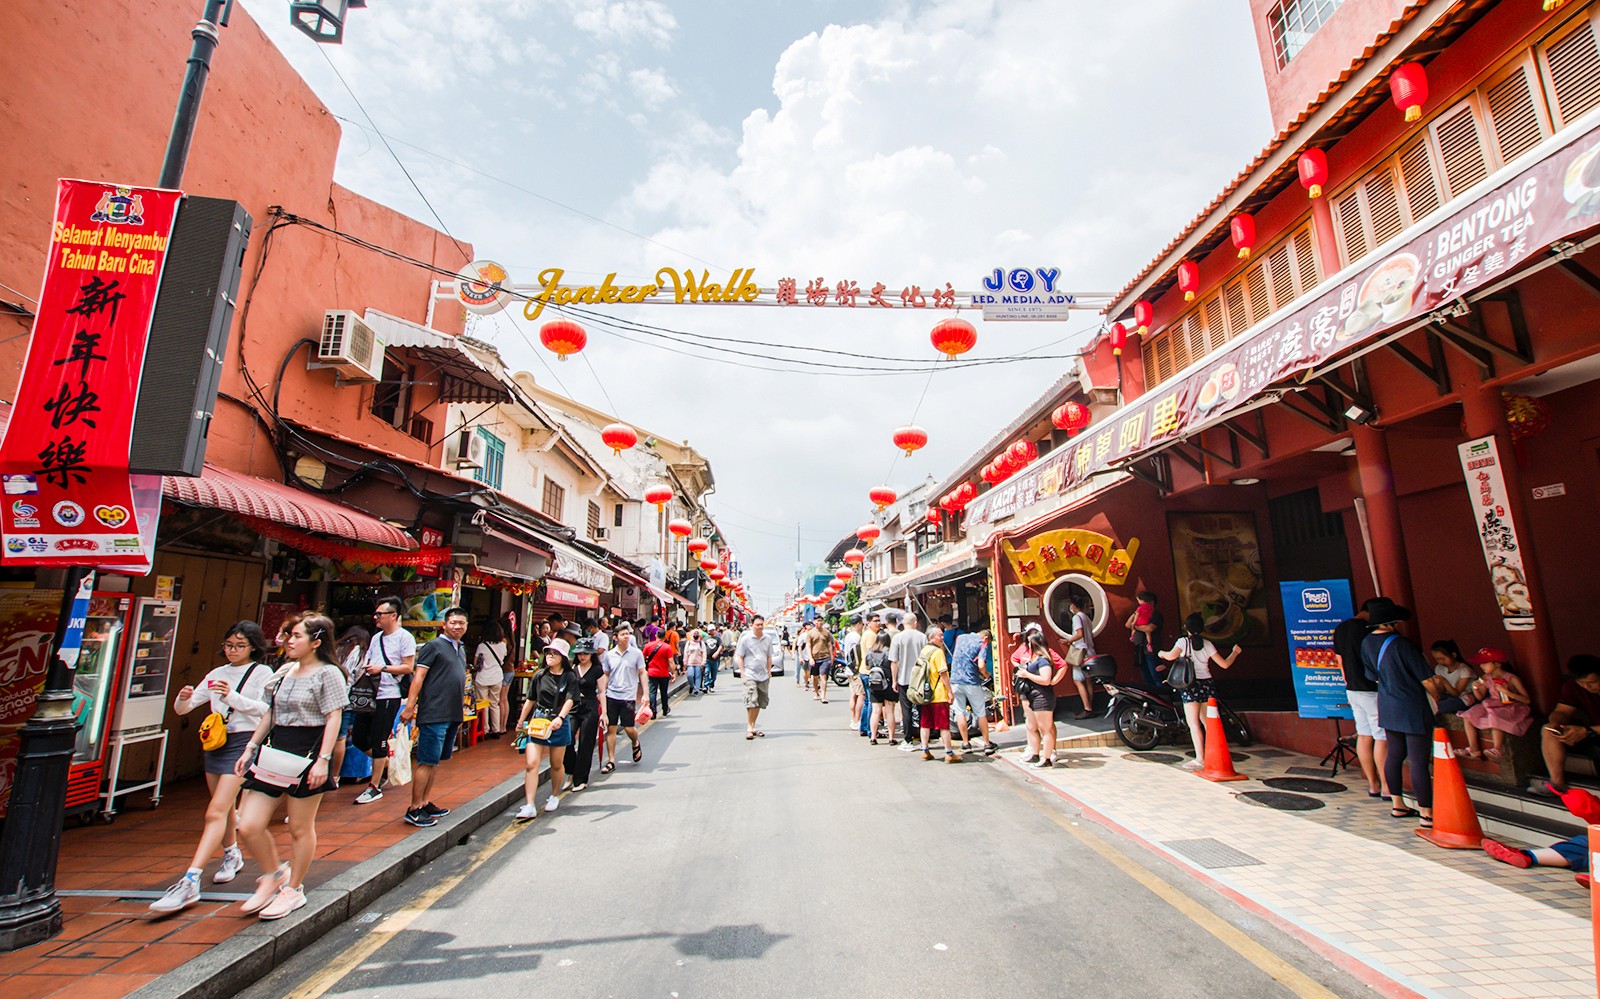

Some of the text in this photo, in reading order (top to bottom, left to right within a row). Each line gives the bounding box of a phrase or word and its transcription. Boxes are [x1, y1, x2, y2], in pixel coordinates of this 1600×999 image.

[1434, 176, 1538, 262] BENTONG
[53, 221, 104, 246] Selamat
[1433, 210, 1536, 279] GINGER TEA
[60, 247, 156, 275] Tahun Baru Cina
[983, 267, 1060, 293] JOY
[523, 266, 762, 322] Jonker Walk
[972, 295, 1076, 304] LED. MEDIA. ADV.
[1249, 345, 1274, 365] NEST
[1250, 332, 1281, 356] BIRD'S
[33, 276, 127, 490] 新年快樂
[991, 485, 1017, 511] KACIP
